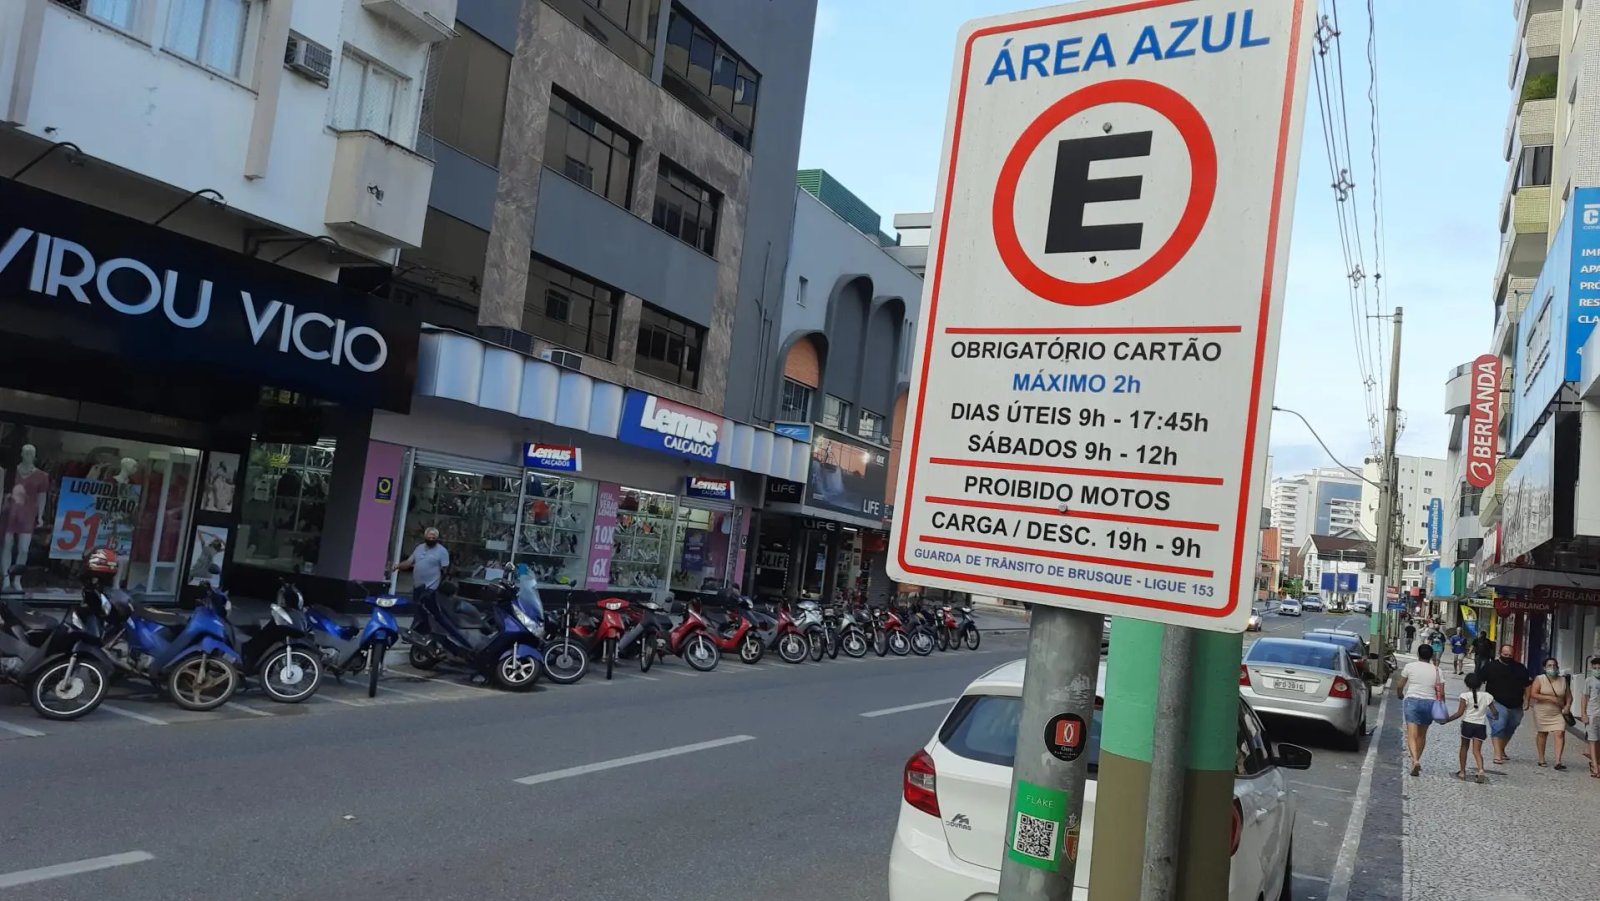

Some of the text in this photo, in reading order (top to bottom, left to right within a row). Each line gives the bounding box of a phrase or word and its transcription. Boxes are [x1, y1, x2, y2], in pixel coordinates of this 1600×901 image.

[984, 9, 1270, 86] ÁREA AZUL
[1045, 130, 1153, 254] E
[240, 290, 388, 372] VICIO
[951, 337, 1222, 362] OBRIGATÓRIO CARTÃO
[1012, 369, 1141, 393] MÁXIMO 2h
[640, 395, 718, 446] Lemus
[950, 403, 1000, 422] DIAS
[1007, 401, 1071, 425] ÚTEIS
[1078, 408, 1105, 427] 9h
[1129, 410, 1209, 432] 17:45h
[1473, 361, 1496, 459] BERLANDA
[664, 435, 713, 458] CALÇADOS
[967, 431, 1077, 459] SÁBADOS
[1084, 441, 1111, 461] 9h
[1136, 444, 1178, 466] 12h
[771, 483, 796, 494] LIFE
[964, 475, 1171, 511] PROIBIDO MOTOS
[863, 498, 880, 516] LIFE
[931, 511, 1008, 538] CARGA
[1013, 519, 1021, 538] /
[1026, 520, 1096, 547] DESC.
[1106, 530, 1147, 552] 19h
[1171, 537, 1201, 559] 9h
[914, 548, 961, 564] GUARDA
[965, 554, 981, 566] DE
[985, 554, 1044, 575] TRÂNSITO
[1047, 565, 1064, 577] DE
[1068, 568, 1132, 587] BRUSQUE
[1144, 577, 1186, 593] LIGUE
[1191, 583, 1214, 597] 153
[1026, 794, 1055, 808] FLAKE
